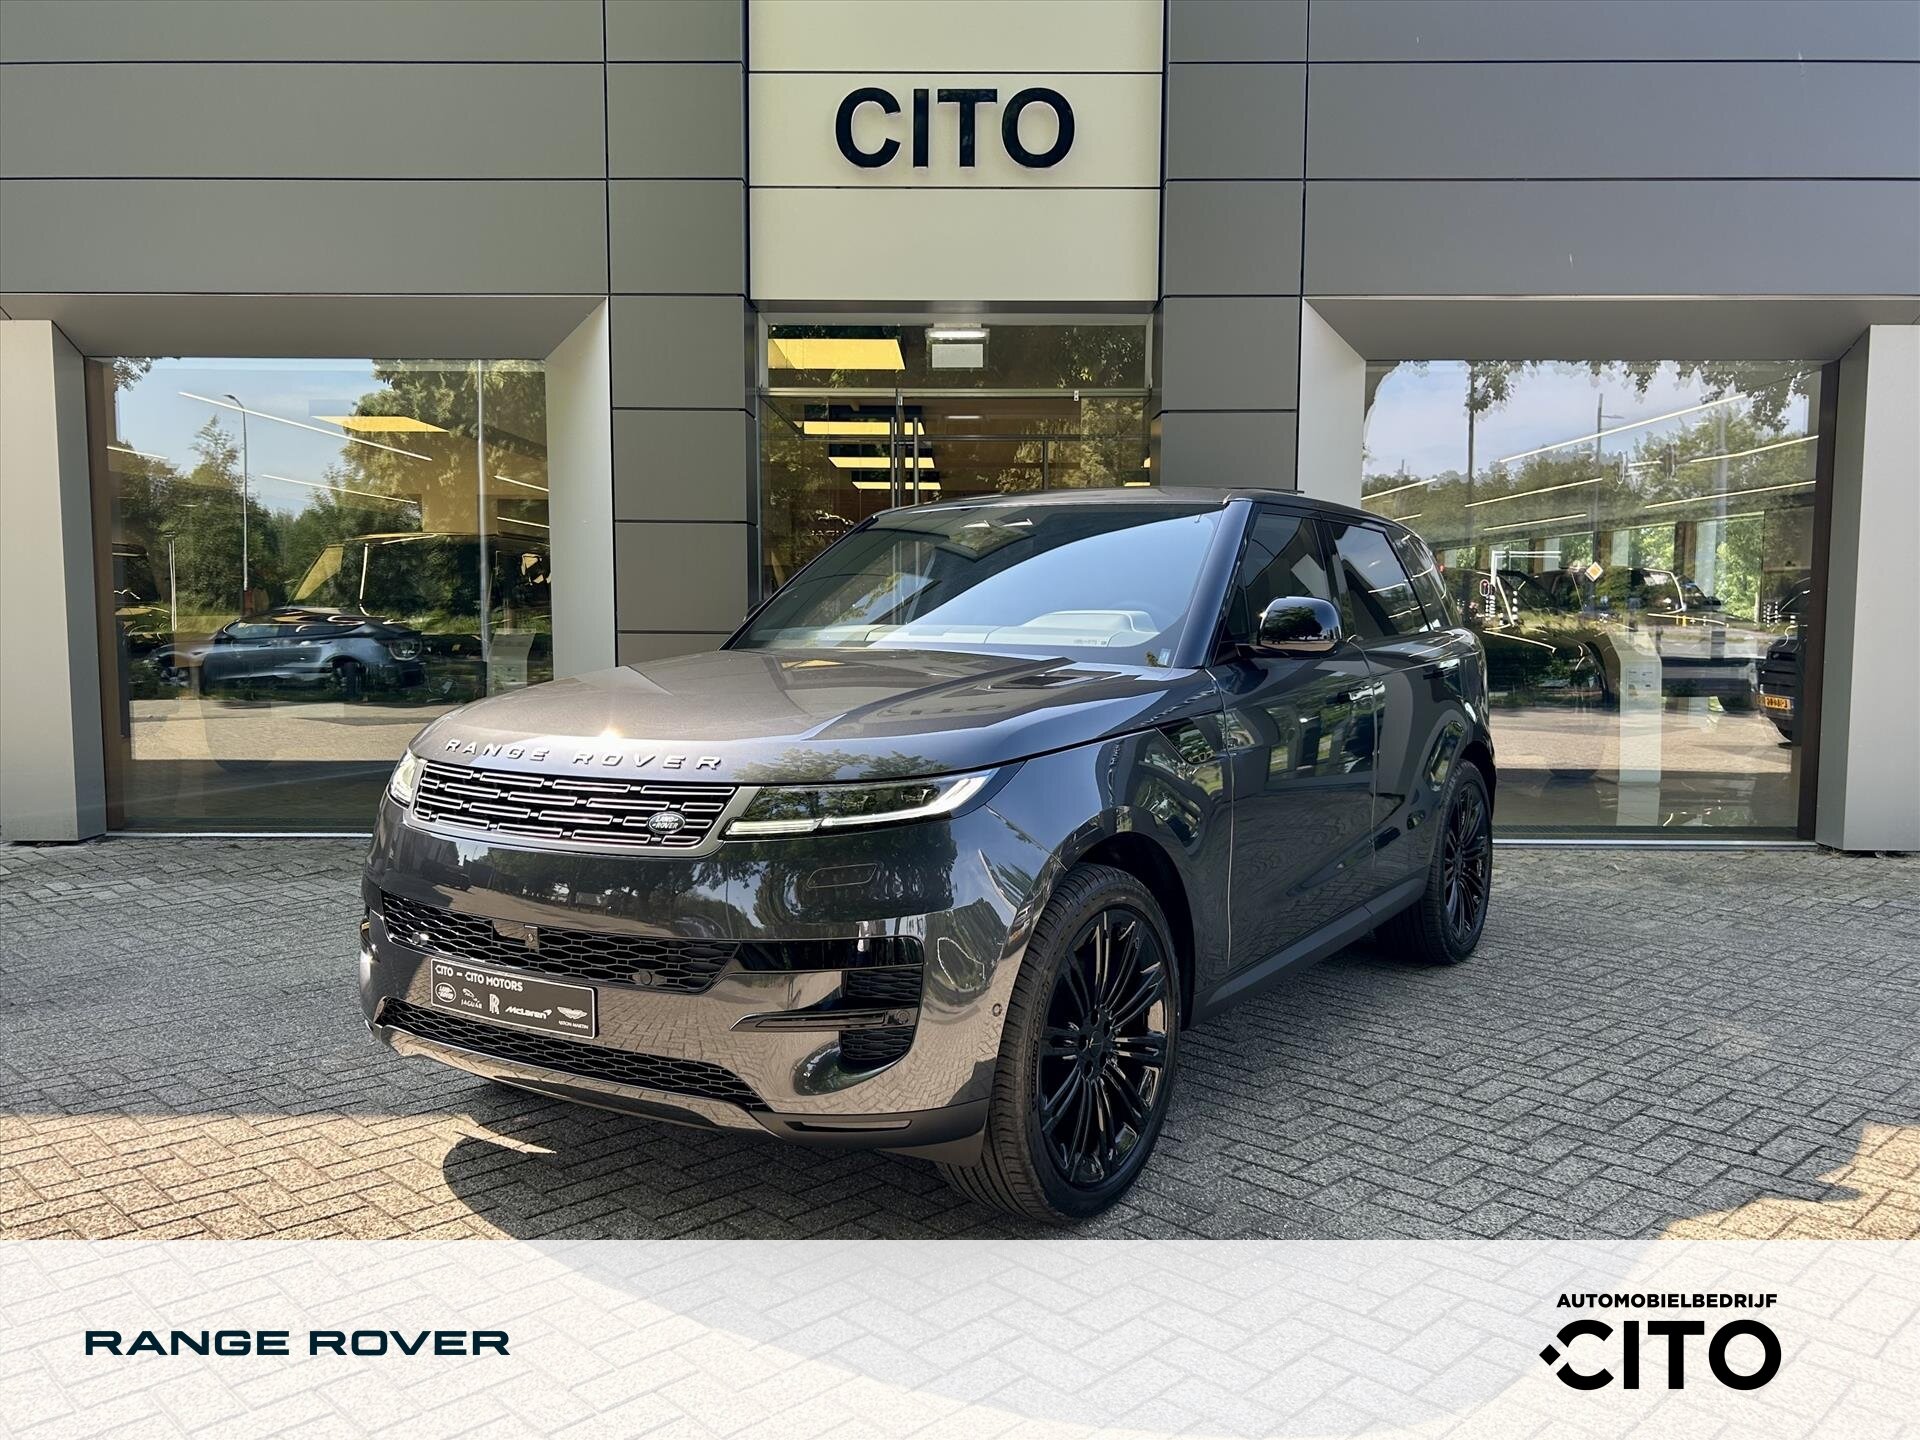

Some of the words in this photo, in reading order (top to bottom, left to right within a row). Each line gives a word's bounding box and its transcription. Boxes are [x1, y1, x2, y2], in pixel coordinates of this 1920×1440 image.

[835, 87, 1076, 168] CITO
[445, 739, 550, 762] RANGE
[572, 751, 721, 770] ROVER
[435, 964, 454, 977] CITO
[465, 971, 485, 984] CITO
[486, 976, 524, 992] MOTORS
[460, 999, 483, 1009] JAGUAR
[505, 1006, 547, 1020] McLaren
